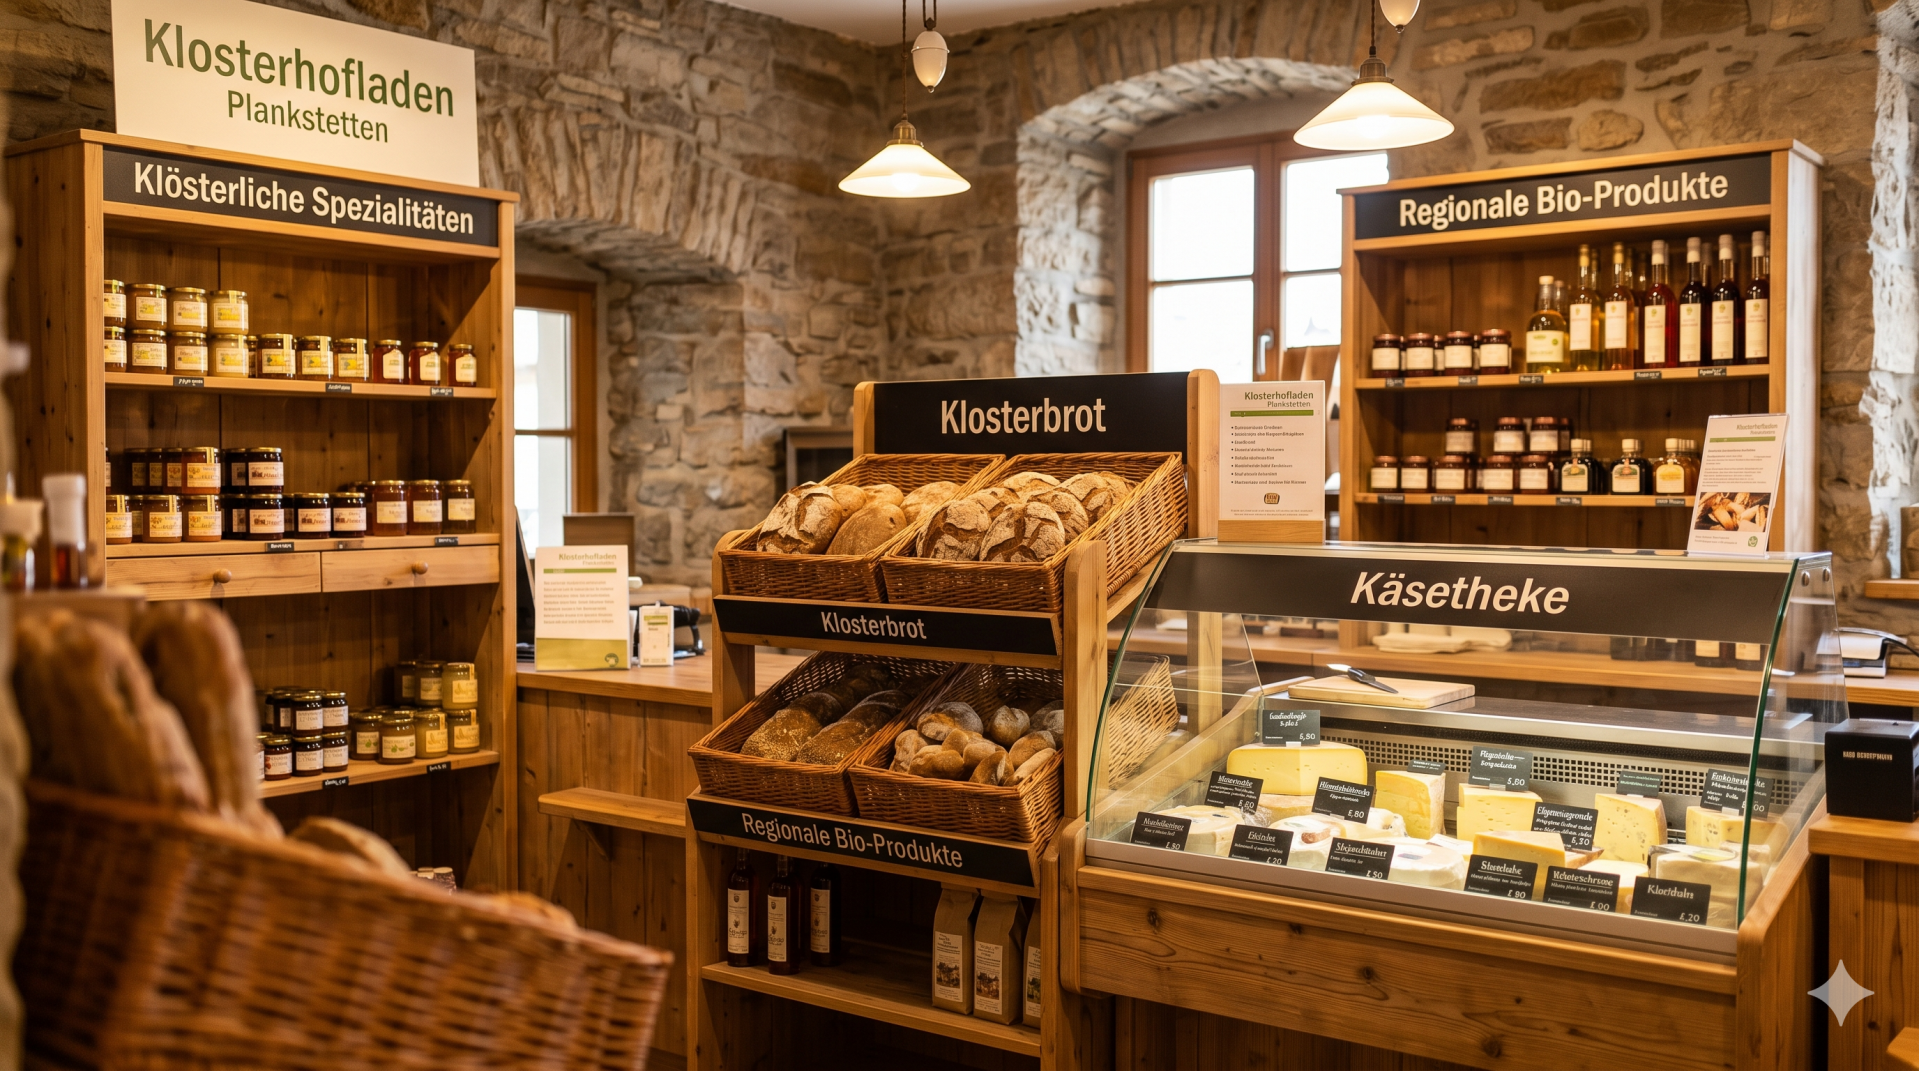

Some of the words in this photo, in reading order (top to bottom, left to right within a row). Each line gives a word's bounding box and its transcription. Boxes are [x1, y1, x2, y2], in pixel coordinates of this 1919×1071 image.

[144, 18, 455, 117] Klosterhofladen
[227, 90, 389, 143] Plankstetten
[134, 161, 305, 214] Klösterliche
[312, 185, 474, 235] Spezialitäten
[1400, 189, 1530, 231] Regionale
[1537, 172, 1729, 215] Bio-Produkte
[941, 397, 1107, 434] Klosterbrot
[1244, 390, 1314, 400] Klosterhofladen
[1350, 571, 1570, 614] Käsetheke
[821, 611, 928, 640] Klosterbrot
[742, 812, 832, 848] Regionale
[834, 826, 964, 868] Bio-Produkte
